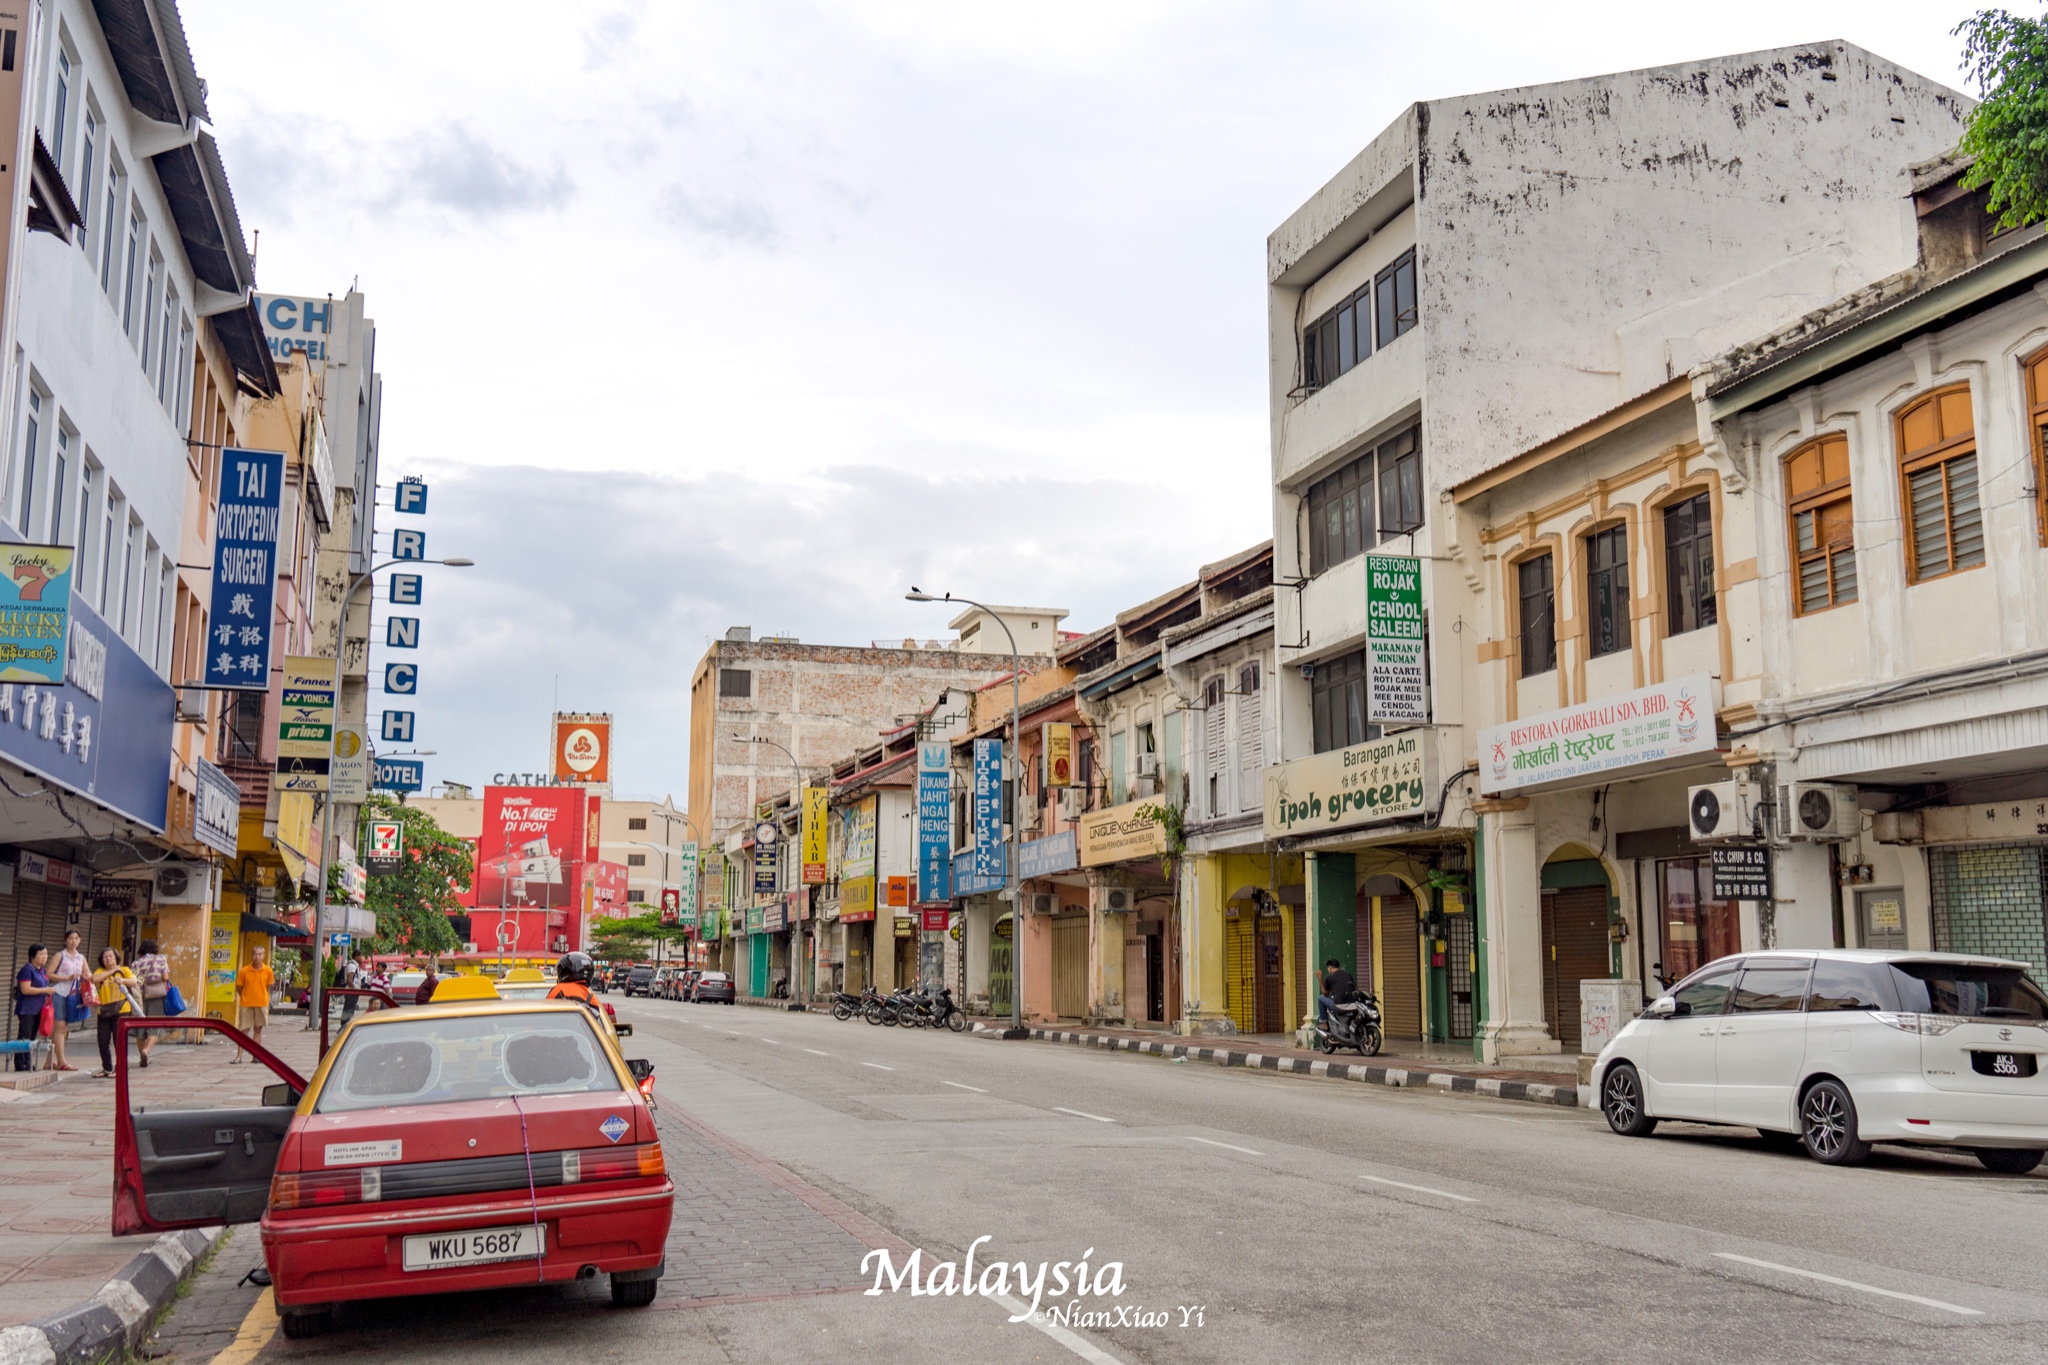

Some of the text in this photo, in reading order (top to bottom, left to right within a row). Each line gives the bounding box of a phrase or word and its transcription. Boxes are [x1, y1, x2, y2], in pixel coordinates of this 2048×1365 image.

[237, 461, 267, 498] TAI
[218, 503, 278, 542] ORTOPEDIK
[10, 554, 49, 567] Lucky
[221, 547, 267, 585] SURGERI
[1370, 558, 1418, 573] RESTORAN
[14, 565, 50, 601] 7
[1373, 572, 1415, 590] ROJAK
[1370, 601, 1421, 619] CENDOL
[0, 611, 64, 627] LUCKY
[0, 624, 63, 639] SEVEN
[214, 624, 264, 646] 骨骼
[1370, 620, 1421, 638] SALEEM
[1371, 643, 1421, 653] MAKANAN &
[211, 653, 263, 676] 專科
[1377, 653, 1416, 664] MINUMAN
[1372, 666, 1422, 675] ALA CARTE
[294, 677, 331, 687] Finnex
[1396, 676, 1421, 684] CANAI
[1374, 684, 1422, 693] ROJAK MEE
[303, 694, 329, 704] YONEX
[1510, 694, 1669, 747] RESTORAN GORKHALI SDN. BHD.
[1635, 725, 1643, 733] 011
[1647, 722, 1658, 731] 3611
[1659, 719, 1671, 728] 6602
[288, 725, 325, 739] prince
[1636, 736, 1644, 745] 012
[1649, 734, 1657, 743] 708
[1658, 731, 1669, 740] 2403
[1344, 737, 1416, 767] Barangan Am
[1526, 773, 1545, 784] JALAN
[1546, 769, 1562, 779] DATO
[1563, 766, 1576, 777] ONN
[1604, 757, 1622, 768] 30300
[1642, 748, 1668, 760] PERAK.
[373, 766, 420, 785] HOTEL
[493, 773, 576, 787] CATHAY
[921, 777, 948, 789] TUKANG
[921, 791, 947, 803] JAHIT
[1279, 777, 1424, 829] ipoh grocery
[500, 807, 528, 820] No.1
[922, 806, 947, 817] NGAI
[977, 741, 989, 875] MEDICARE POLIKELINIK
[1372, 803, 1408, 816] STORE
[505, 822, 547, 831] DI IPOH
[811, 790, 819, 861] PATHLAB
[921, 820, 948, 831] HENG
[378, 827, 395, 849] 7
[921, 834, 947, 842] TAILOR
[1713, 851, 1765, 864] C.C. CHUN & CO.
[844, 885, 868, 905] PATHLAB
[1996, 1054, 2013, 1064] AKJ
[1993, 1063, 2018, 1074] 3300
[429, 1232, 522, 1261] WKU 5687
